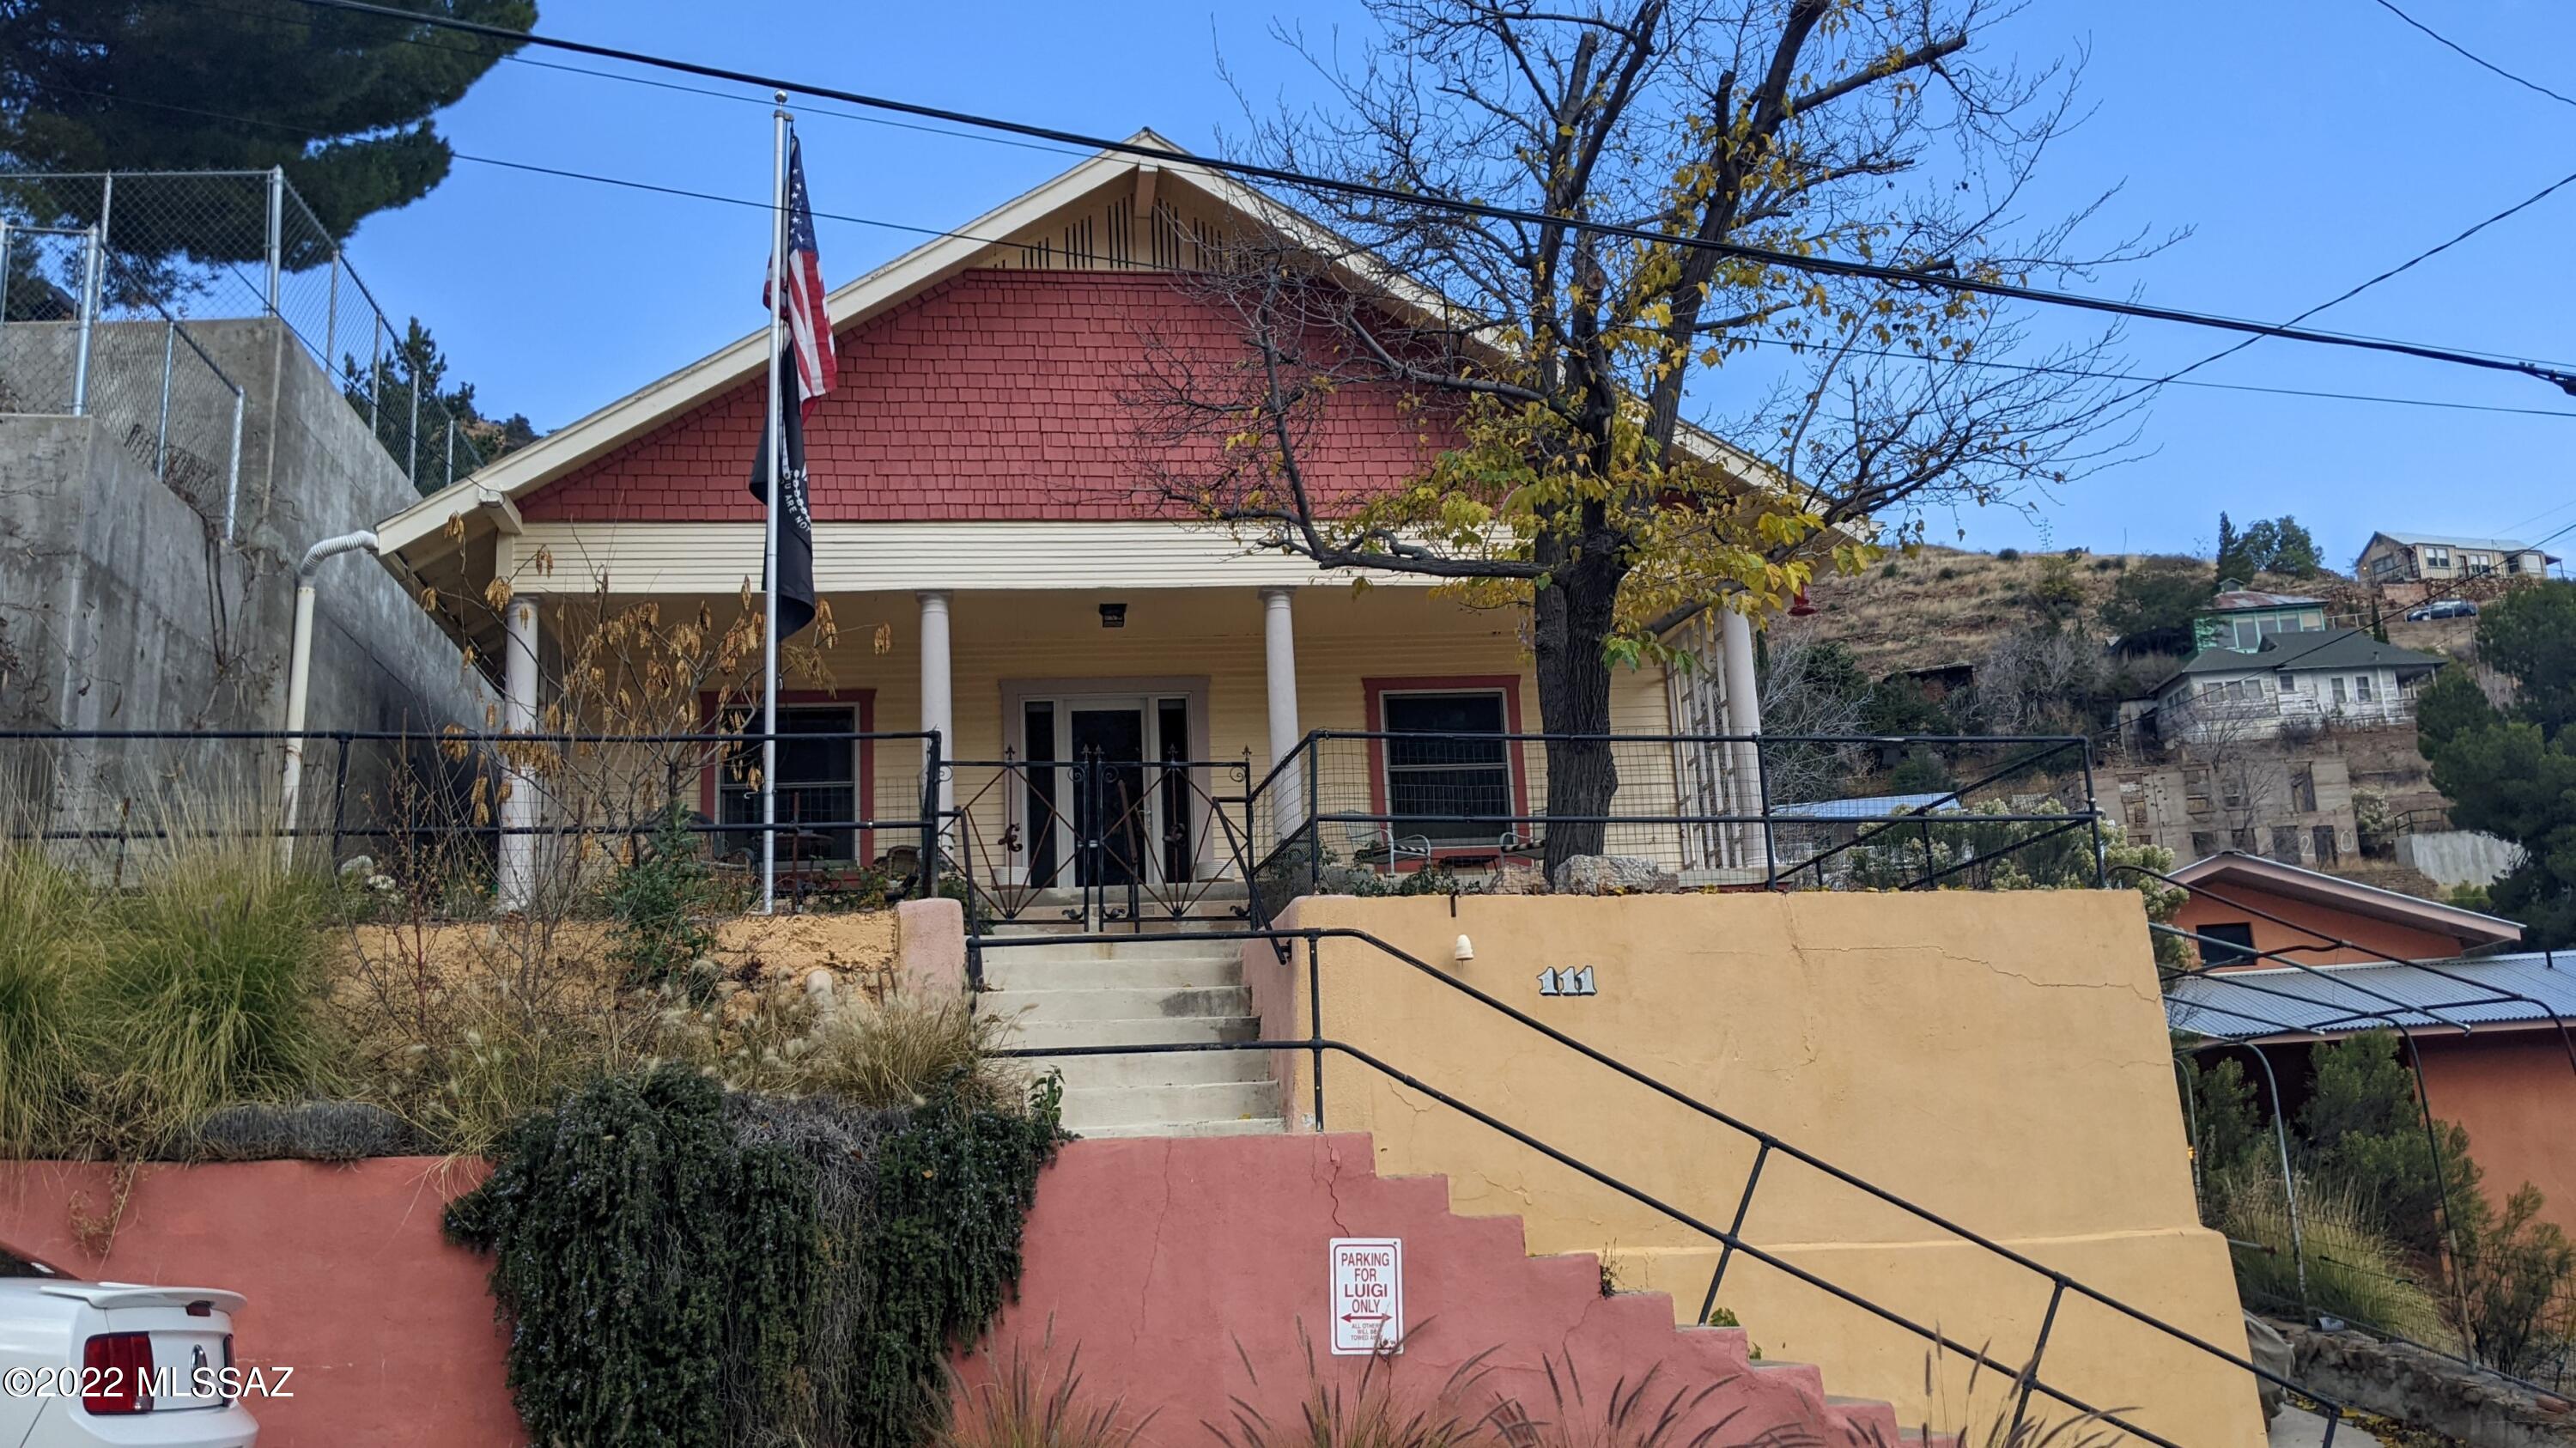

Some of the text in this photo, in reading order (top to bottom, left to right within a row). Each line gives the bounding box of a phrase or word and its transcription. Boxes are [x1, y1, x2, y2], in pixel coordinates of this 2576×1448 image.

[784, 494, 798, 514] ARE
[2300, 835, 2316, 856] 2
[1536, 966, 1597, 996] 111
[1341, 1252, 1389, 1267] PARKING
[1354, 1268, 1376, 1282] FOR
[1345, 1283, 1388, 1298] LUIGI
[1352, 1299, 1380, 1313] ONLY
